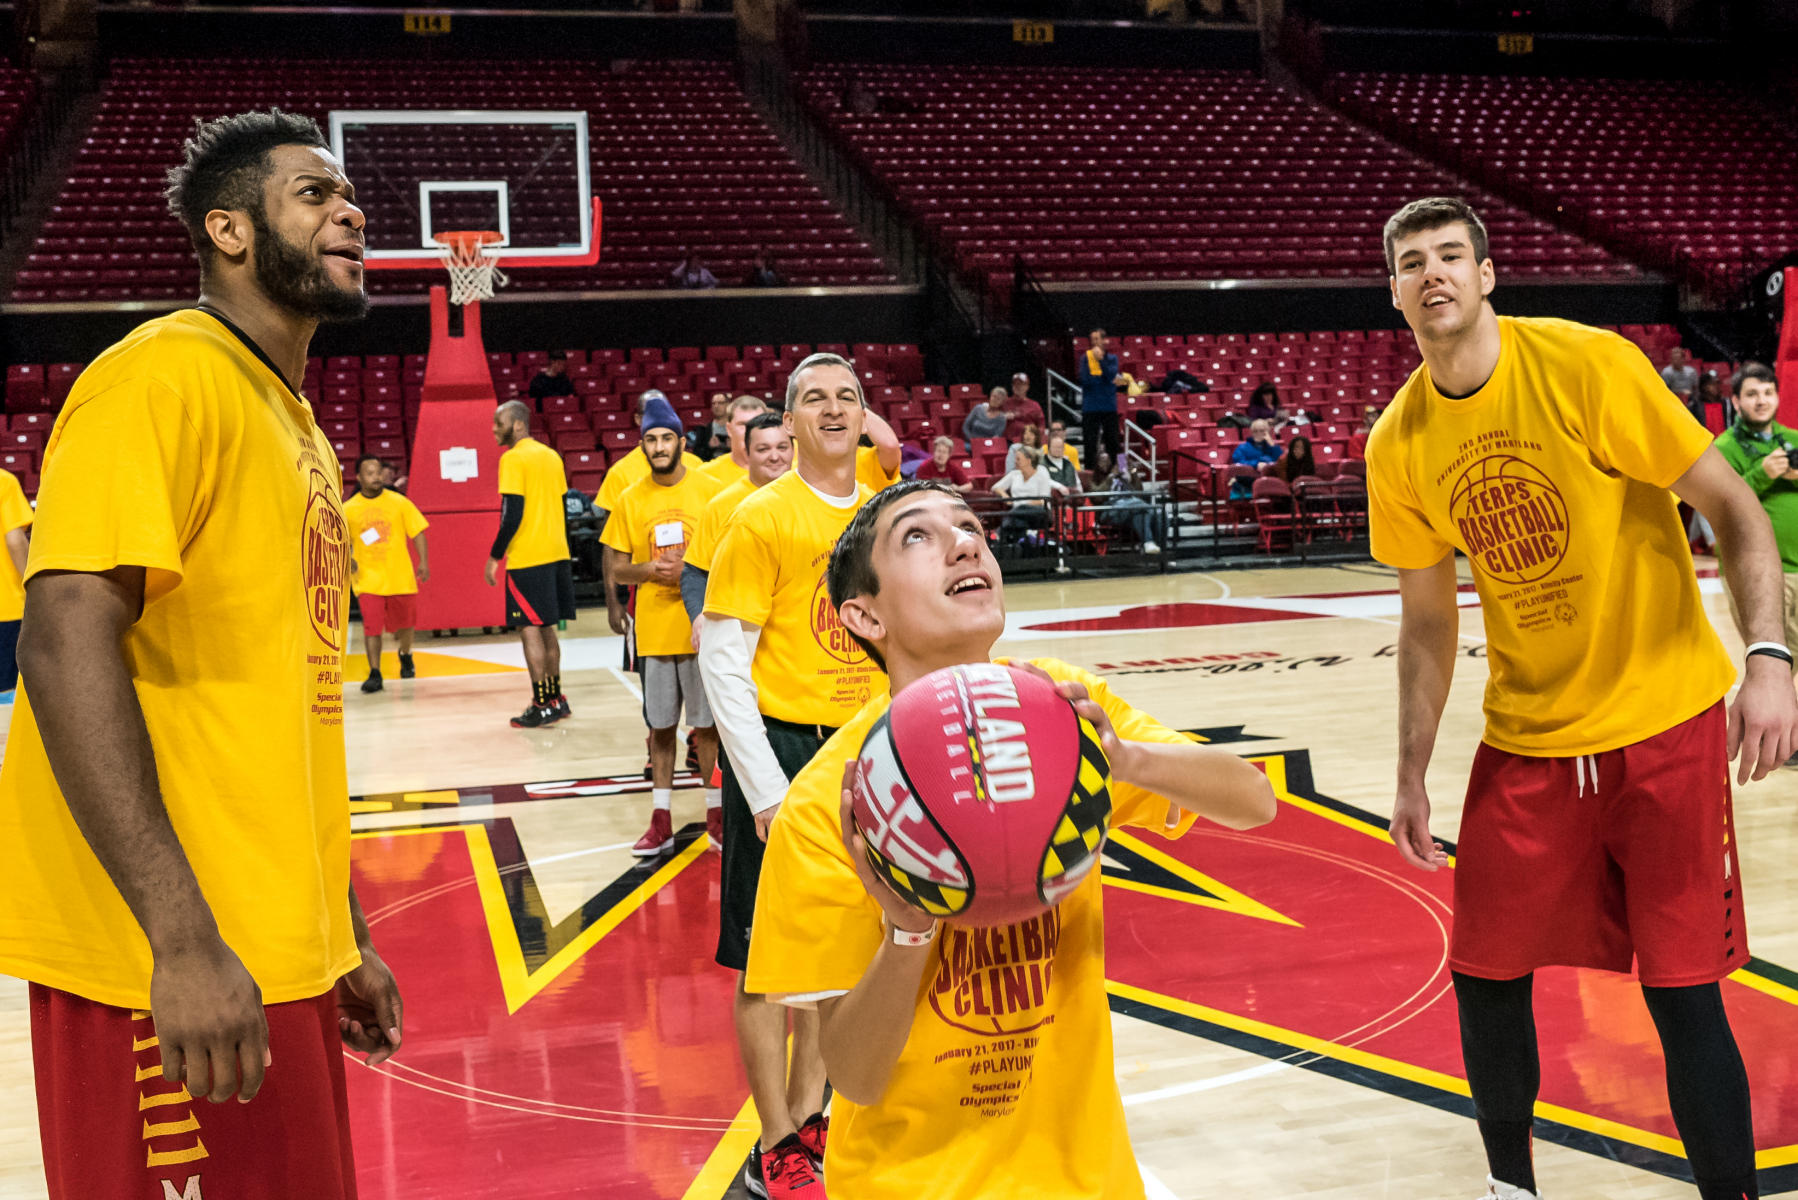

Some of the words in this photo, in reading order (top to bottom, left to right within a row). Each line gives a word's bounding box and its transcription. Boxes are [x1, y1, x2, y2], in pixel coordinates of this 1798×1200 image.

[1477, 429, 1511, 443] ANNUAL
[1436, 447, 1479, 487] UNIVERSITY
[1482, 441, 1493, 453] OF
[1468, 481, 1531, 515] TERPS
[1457, 490, 1565, 557] BASKETBALL
[1484, 533, 1559, 573] CLINIC
[974, 1044, 989, 1056] 21,
[991, 1039, 1015, 1053] 2017
[972, 1079, 1021, 1094] Special
